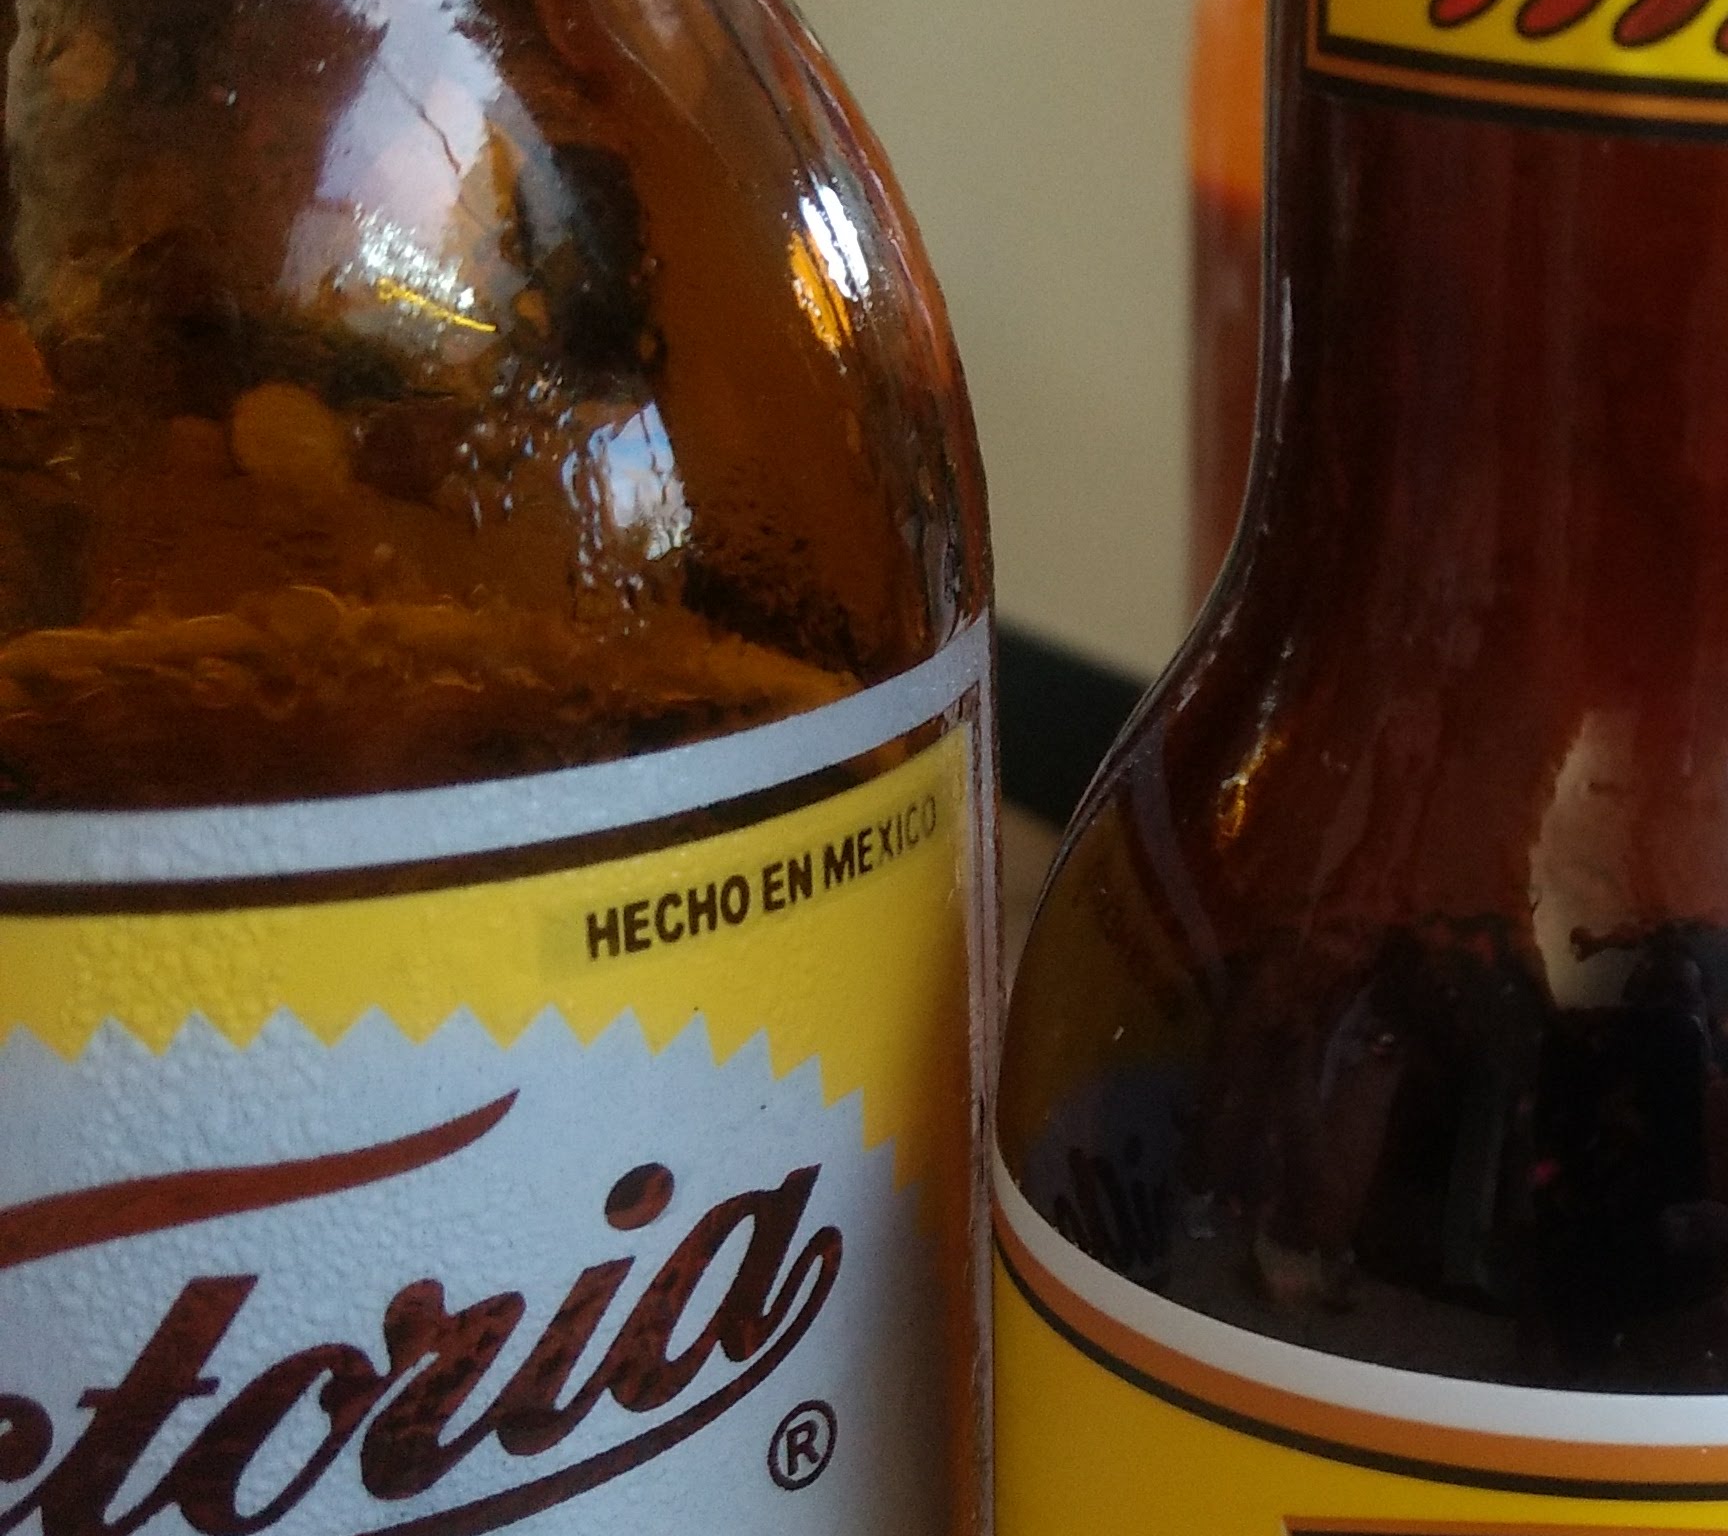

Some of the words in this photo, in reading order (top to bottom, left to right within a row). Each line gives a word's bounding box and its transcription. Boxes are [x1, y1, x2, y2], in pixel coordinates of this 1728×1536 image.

[585, 874, 751, 959] HECHO
[762, 852, 813, 912] EN
[823, 793, 937, 890] MEXICO
